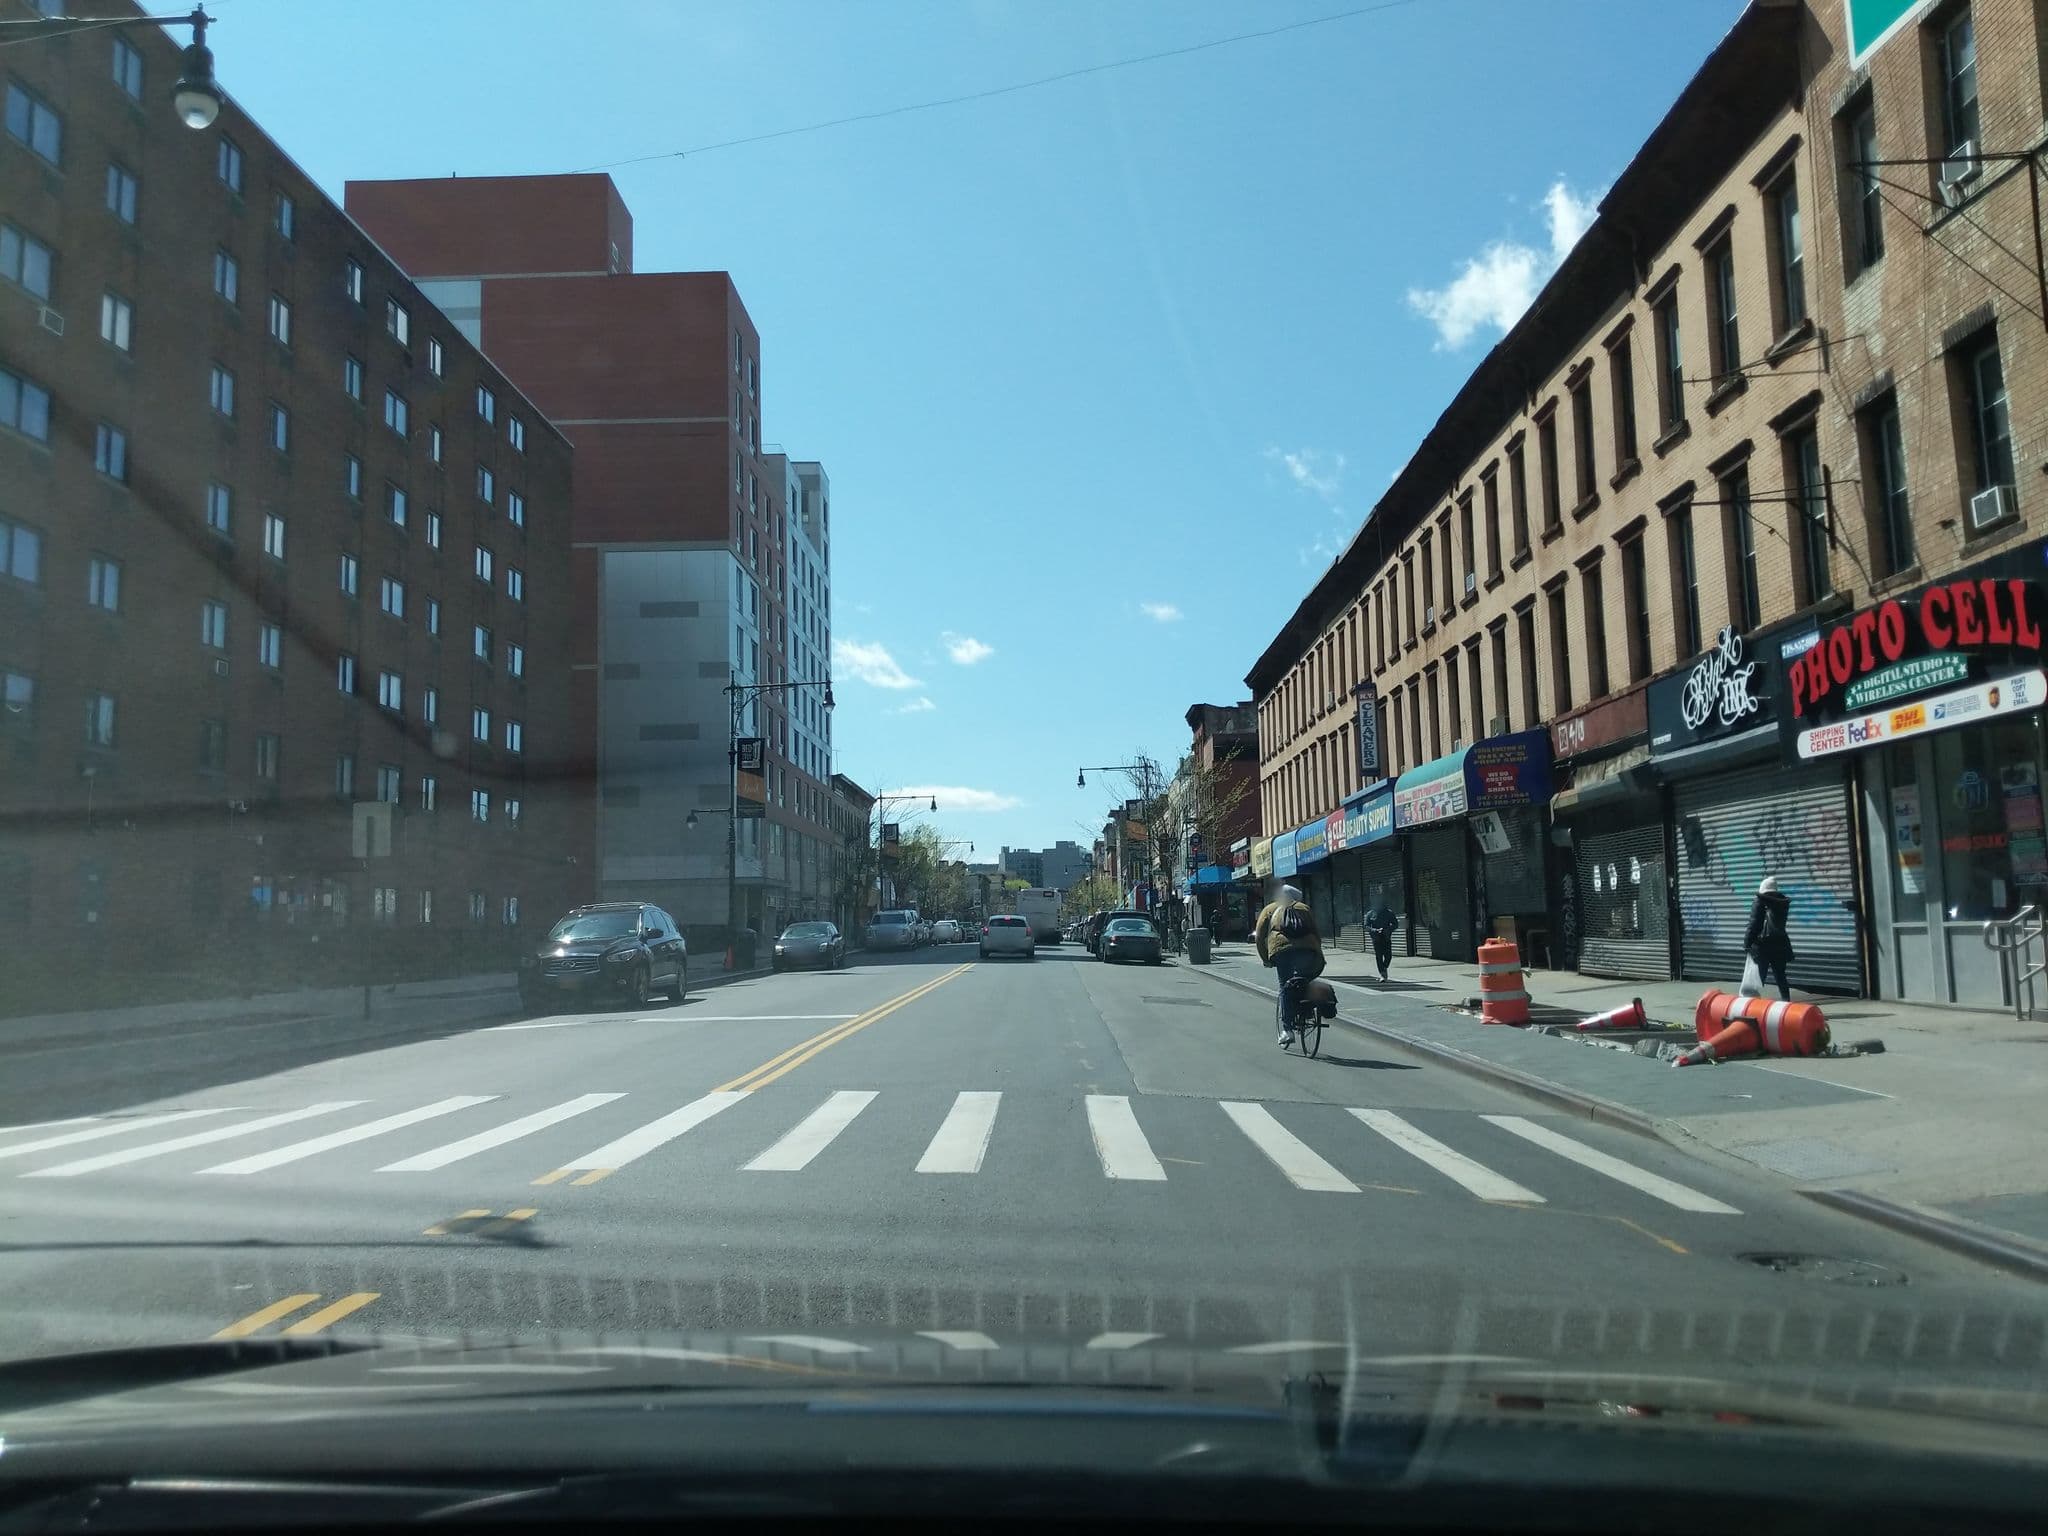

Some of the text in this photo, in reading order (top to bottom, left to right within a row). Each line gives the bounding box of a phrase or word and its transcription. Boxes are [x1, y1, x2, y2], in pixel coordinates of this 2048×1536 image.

[1789, 577, 2041, 718] PHOTO CELL
[1855, 667, 1955, 704] WIRELESS CENTER
[1863, 657, 1943, 690] DIGITAL STUDIO
[1361, 702, 1375, 767] CLEANERS
[1810, 725, 1845, 742] SHIPPING
[1810, 736, 1846, 753] CENTER
[1847, 717, 1883, 744] FedEx
[1487, 785, 1516, 793] SHIRTS
[1346, 811, 1368, 840] BEAUTY
[1368, 803, 1391, 832] SUPPLY
